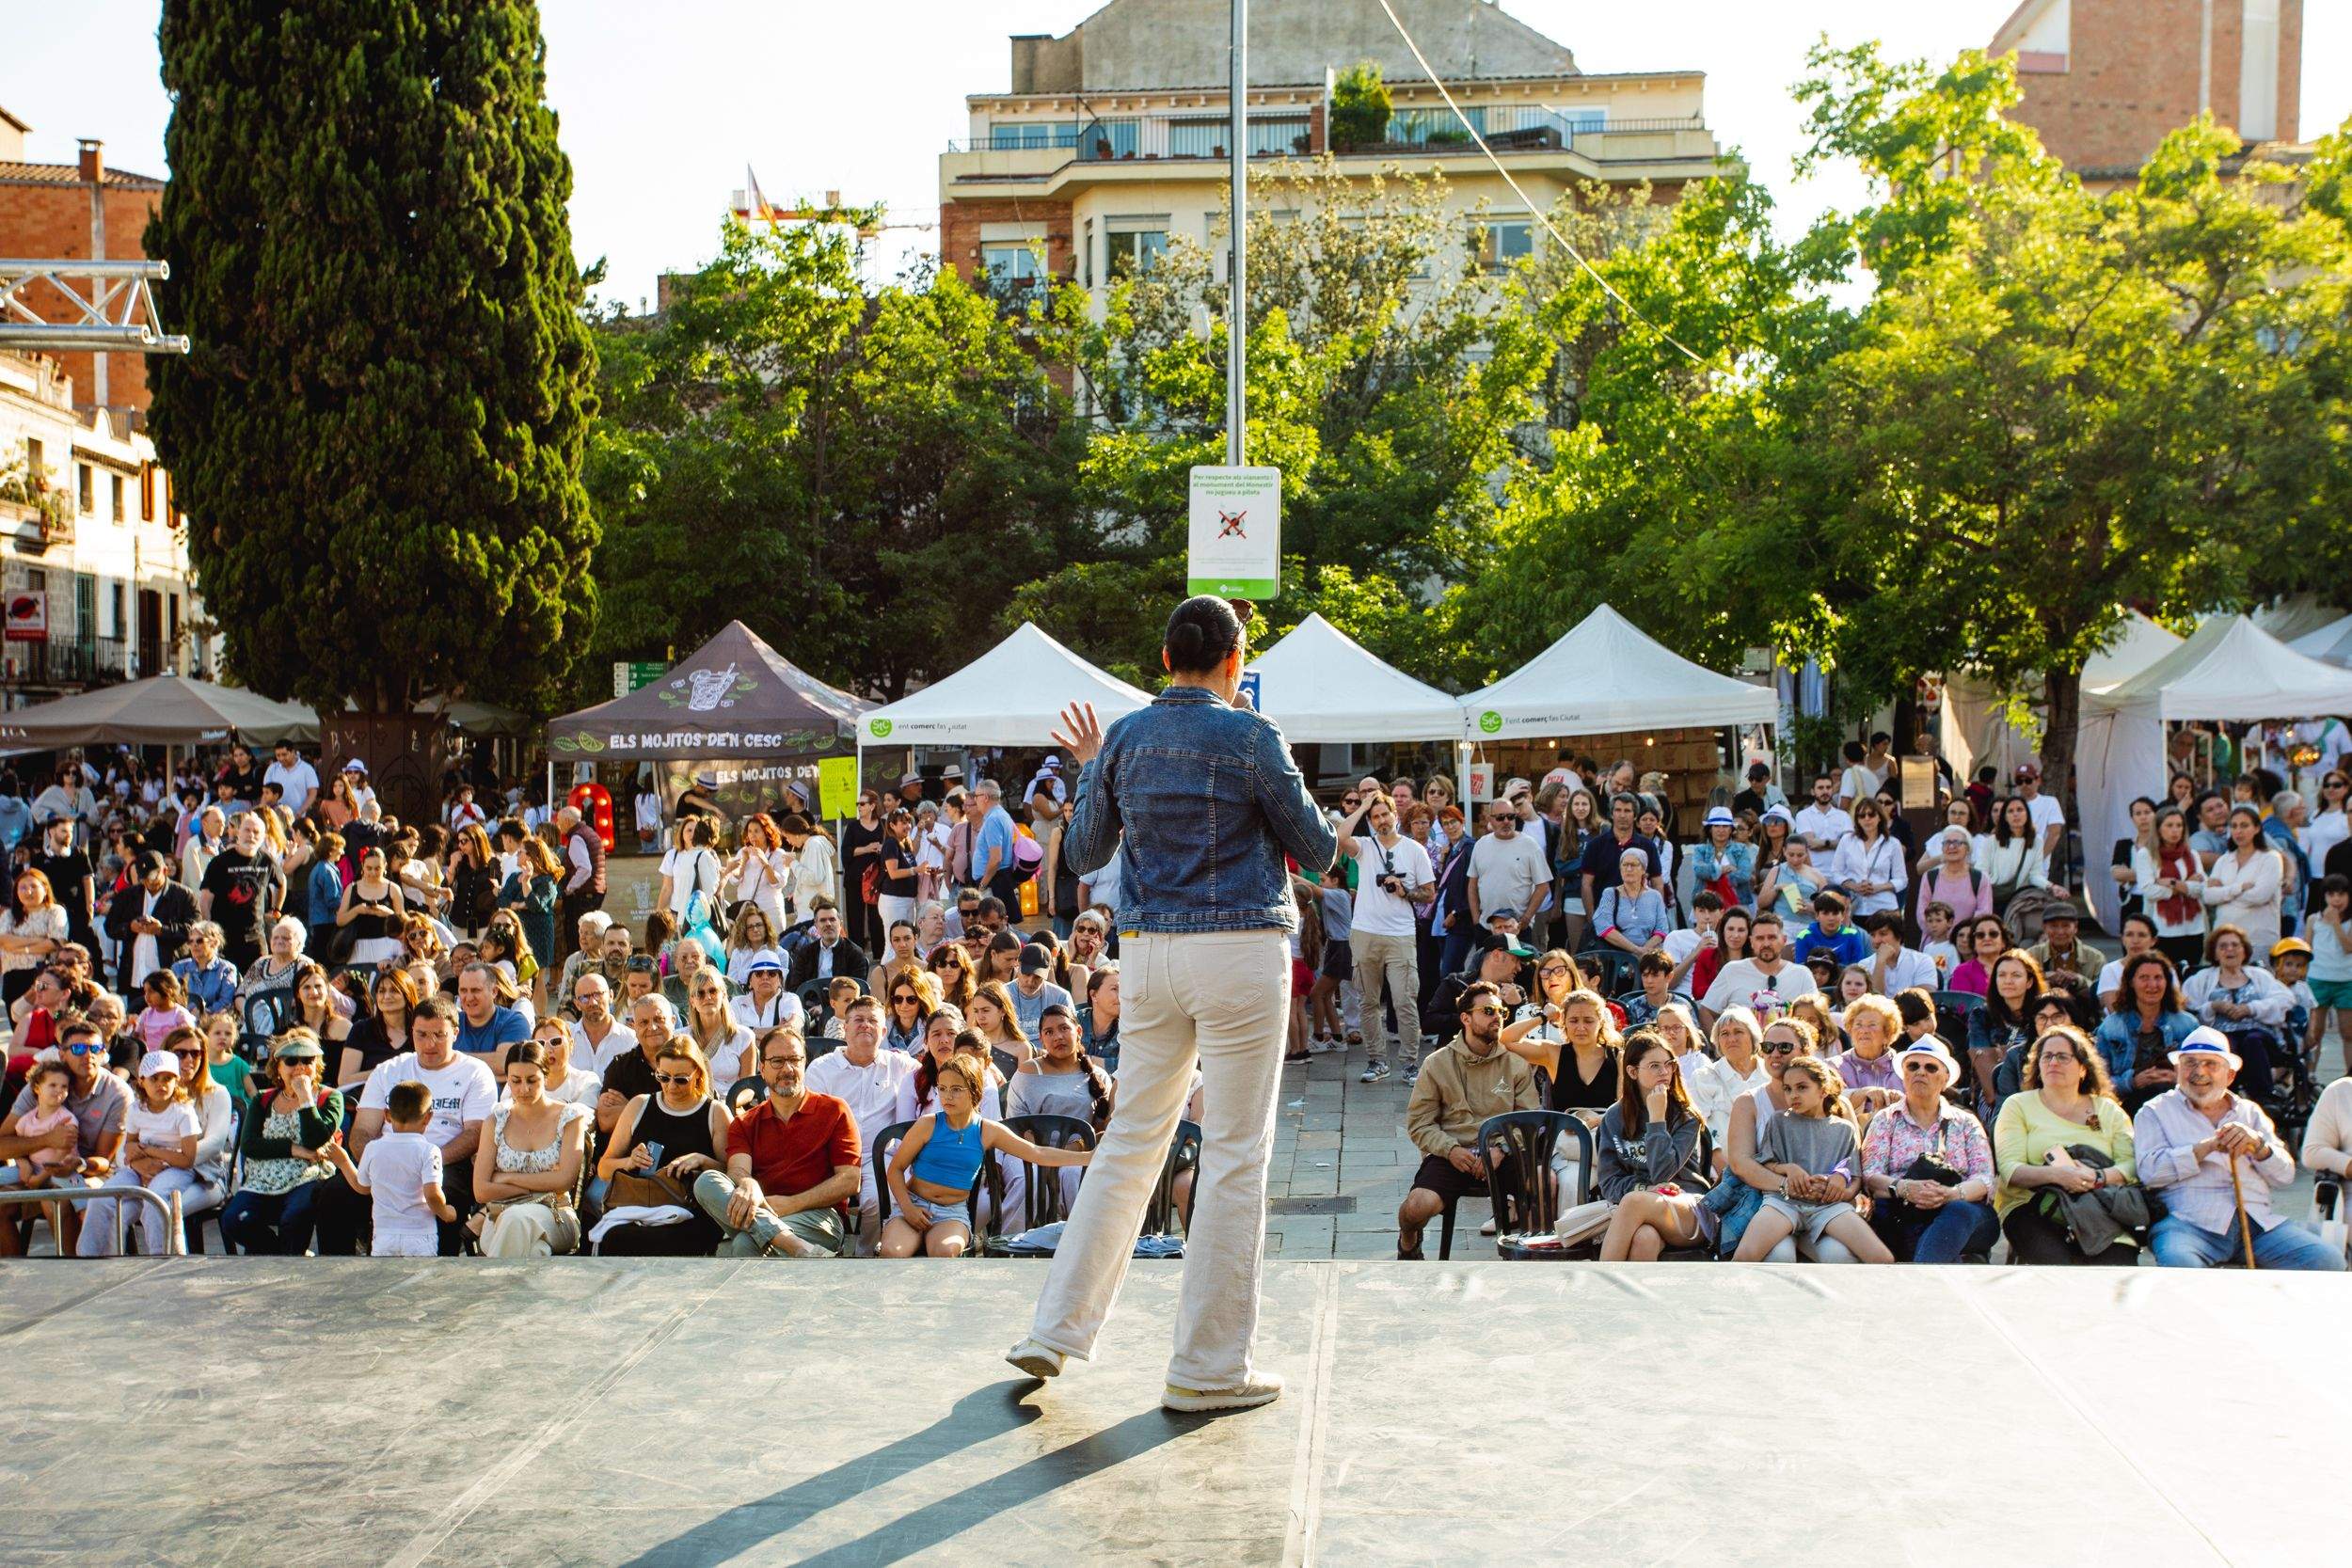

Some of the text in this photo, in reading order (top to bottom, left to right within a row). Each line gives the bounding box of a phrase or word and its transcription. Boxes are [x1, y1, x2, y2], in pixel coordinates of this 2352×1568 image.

[610, 731, 783, 750] ELS MOJITOS DE'N CESC
[716, 770, 739, 784] ELS
[741, 766, 792, 783] MOJITOS
